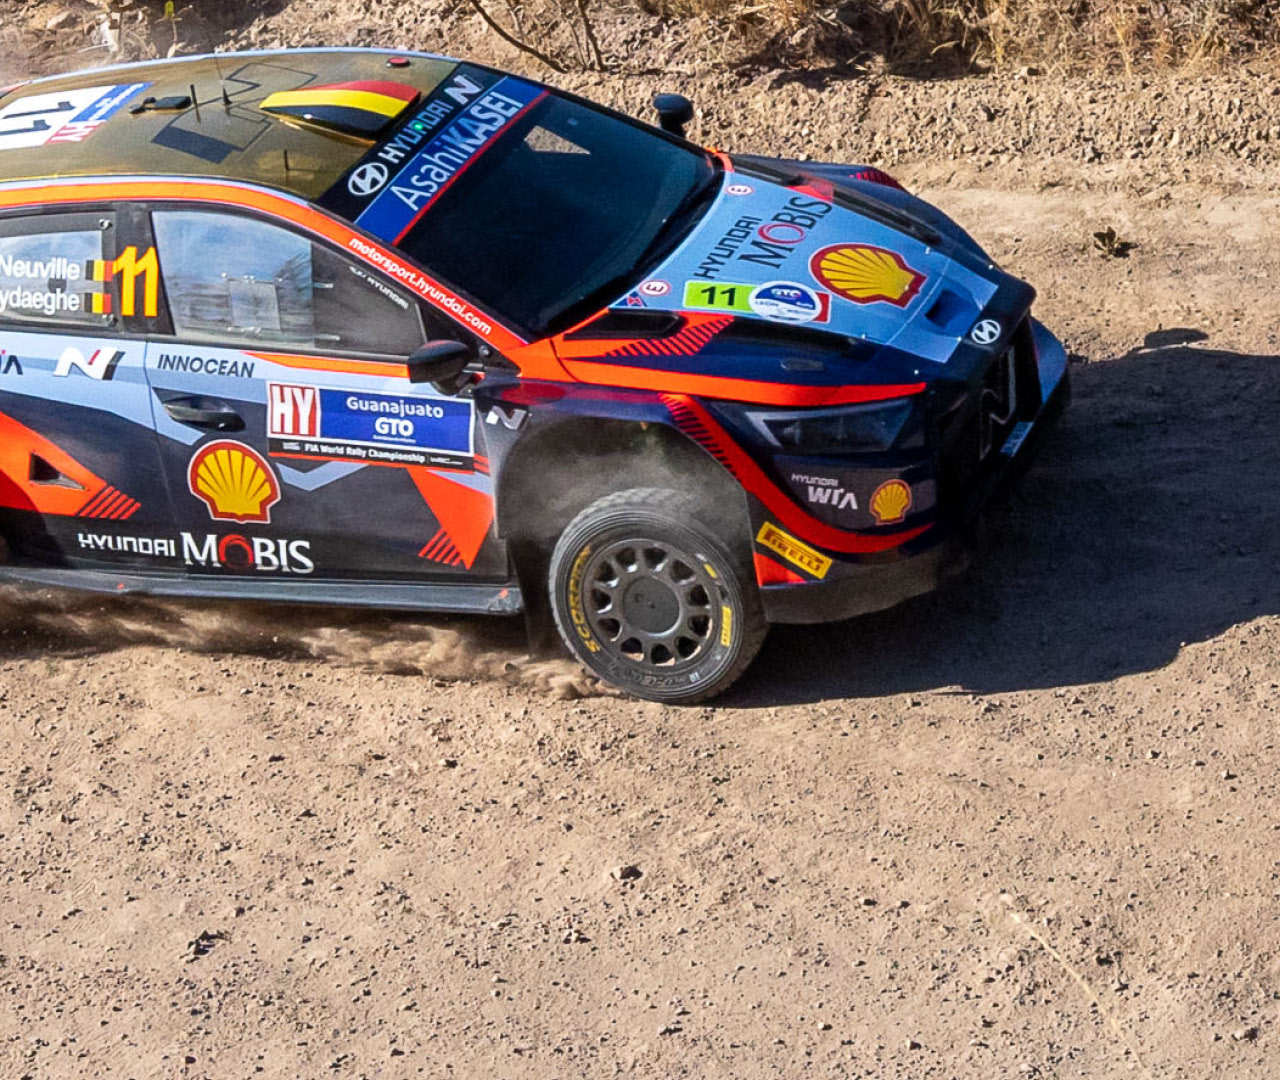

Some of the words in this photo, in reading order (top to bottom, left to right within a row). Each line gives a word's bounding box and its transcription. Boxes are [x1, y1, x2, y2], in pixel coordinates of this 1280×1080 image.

[377, 100, 454, 164] HYUNDAI
[391, 91, 524, 211] AsahiKASEI
[693, 215, 763, 279] HYUNDAI
[739, 196, 833, 269] MOBIS
[112, 246, 159, 317] 11
[349, 237, 492, 336] motorsport.hyundai.com
[700, 287, 737, 306] 11
[157, 353, 256, 379] INNOCEAN
[271, 384, 318, 437] HY
[346, 395, 445, 419] Guanajuato
[374, 417, 415, 437] GTO
[304, 443, 320, 454] FIA
[321, 444, 345, 456] World
[346, 447, 367, 459] Rally
[368, 449, 426, 463] Championship
[791, 473, 839, 487] HYUNDAI
[78, 532, 176, 557] HYUNDAI
[180, 532, 315, 573] MOBIS
